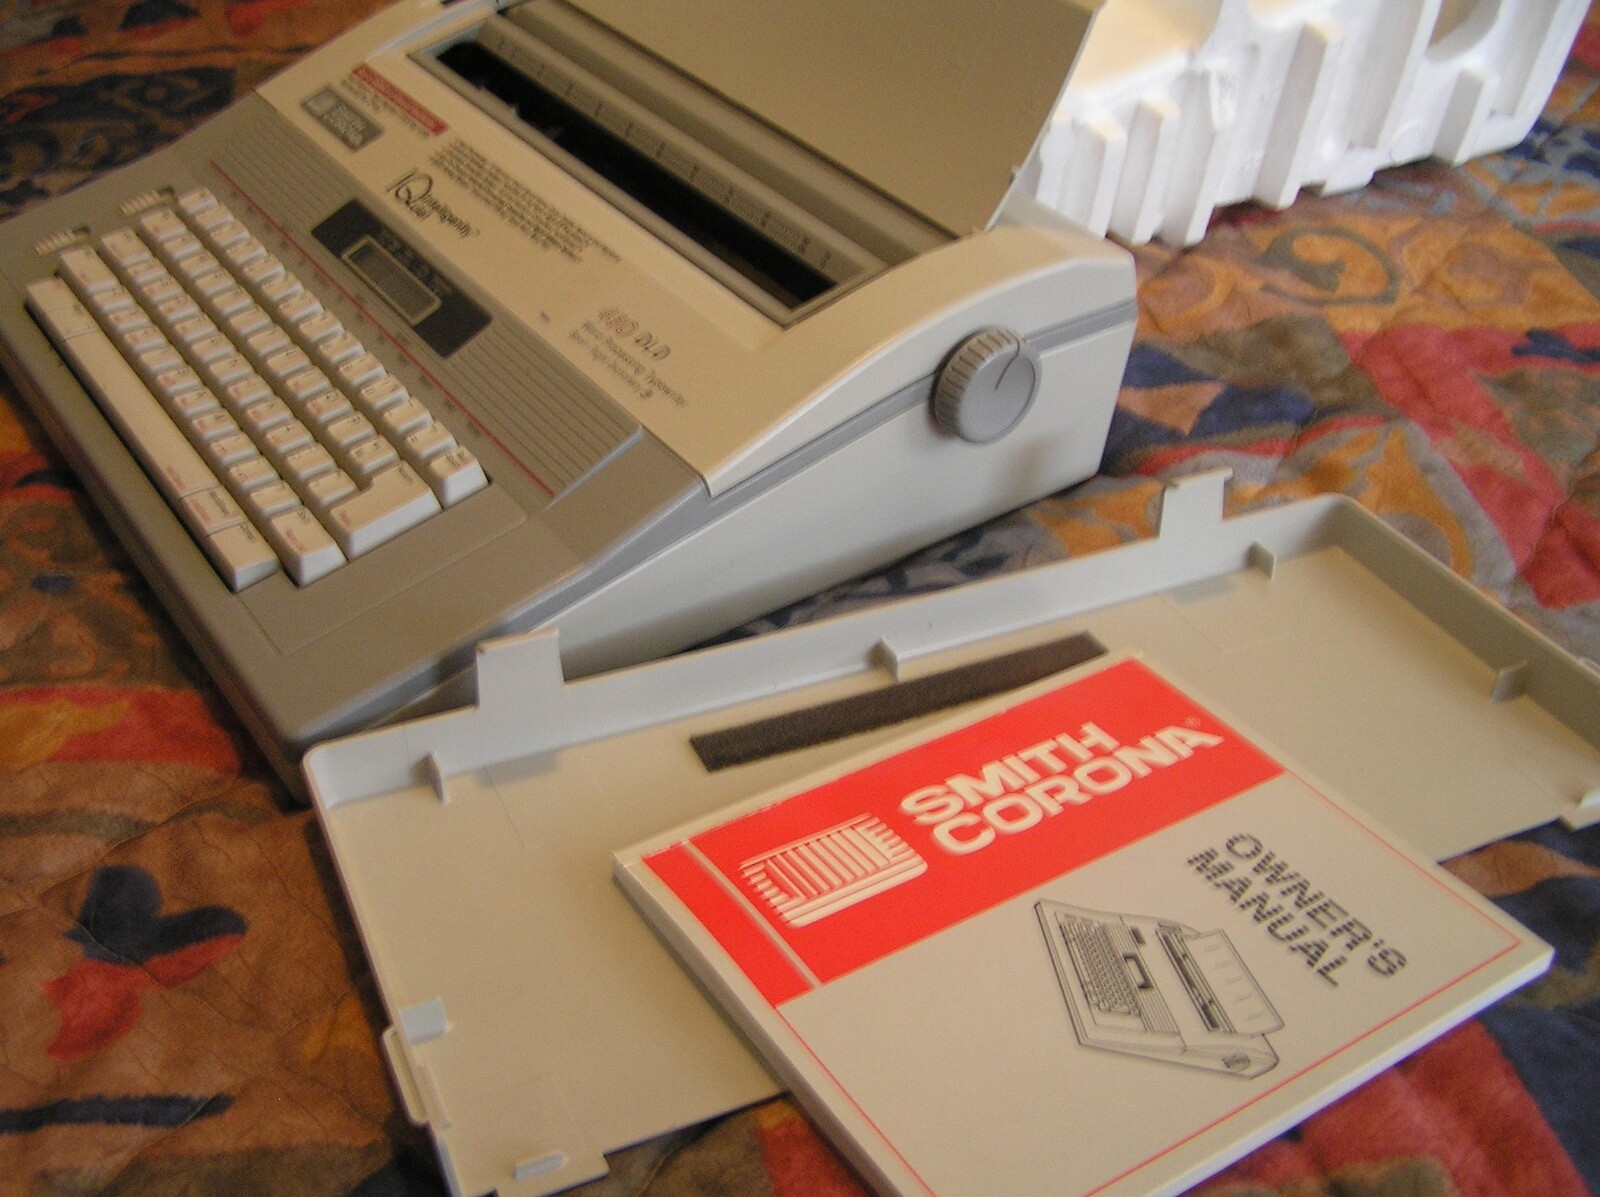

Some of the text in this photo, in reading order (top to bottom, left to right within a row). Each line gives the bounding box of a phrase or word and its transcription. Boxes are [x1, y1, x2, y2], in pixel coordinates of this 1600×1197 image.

[901, 720, 1121, 825] SMITH
[933, 725, 1225, 855] CORONA
[1186, 846, 1348, 989] MANUAL
[1225, 832, 1408, 978] OWNER'S
